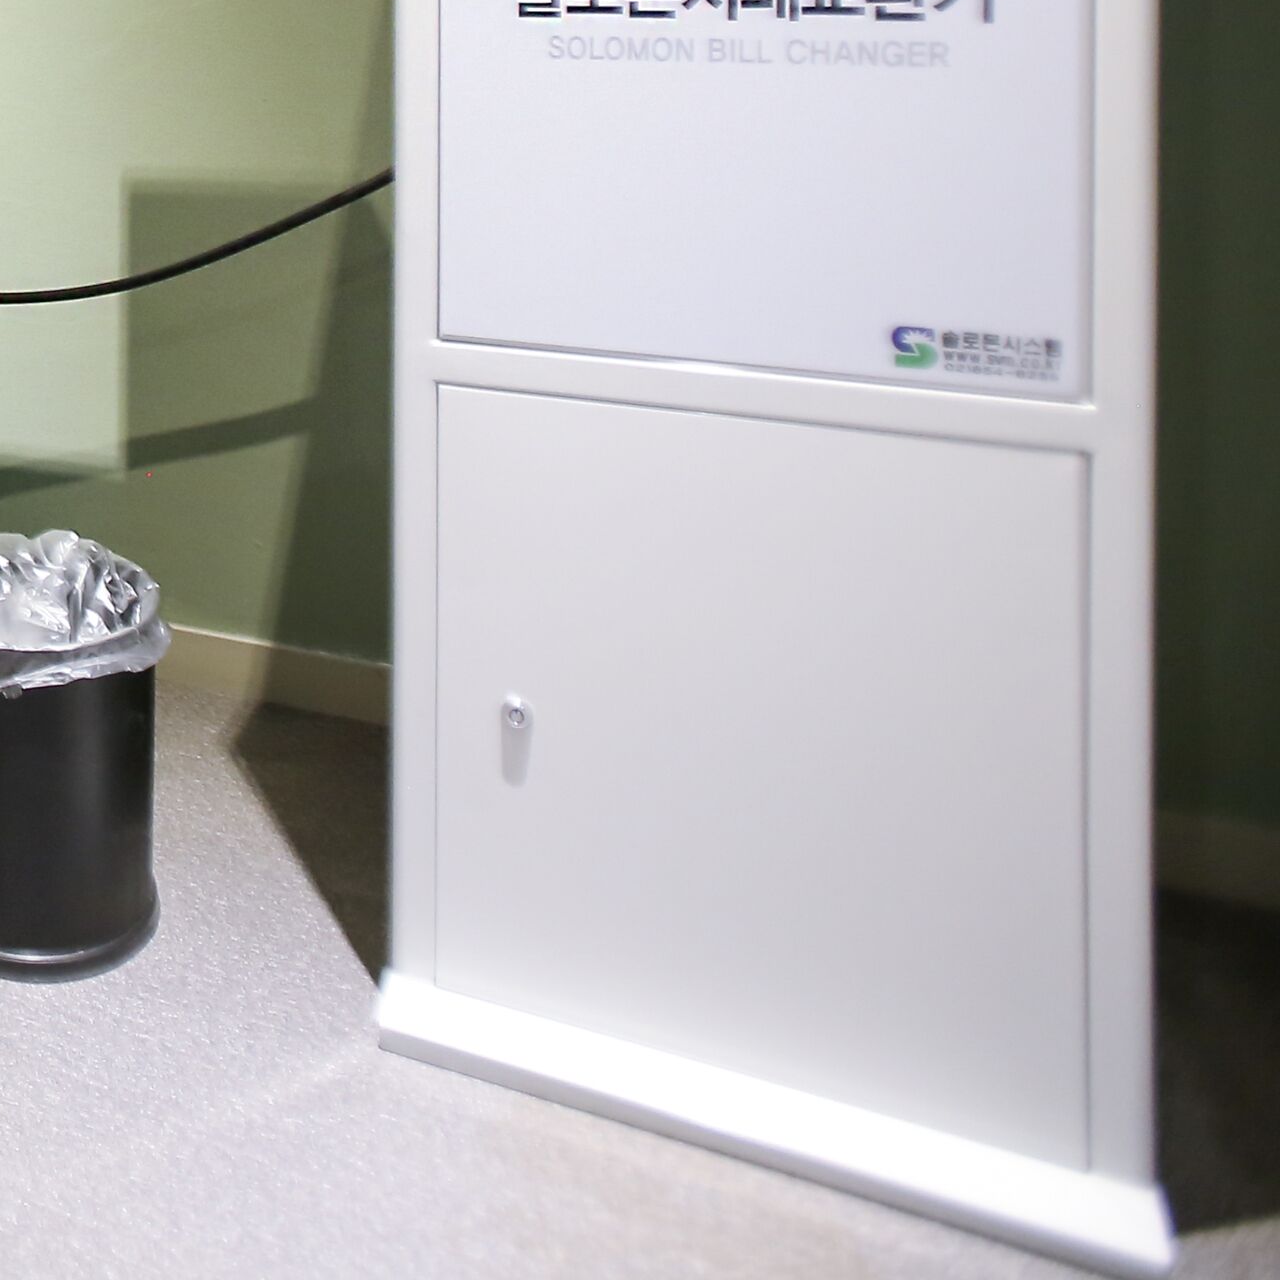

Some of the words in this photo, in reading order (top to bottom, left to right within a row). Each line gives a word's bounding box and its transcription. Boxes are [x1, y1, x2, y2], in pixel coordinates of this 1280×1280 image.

[548, 35, 695, 63] SOLOMON
[708, 38, 773, 65] BILL
[786, 39, 951, 69] CHANGER
